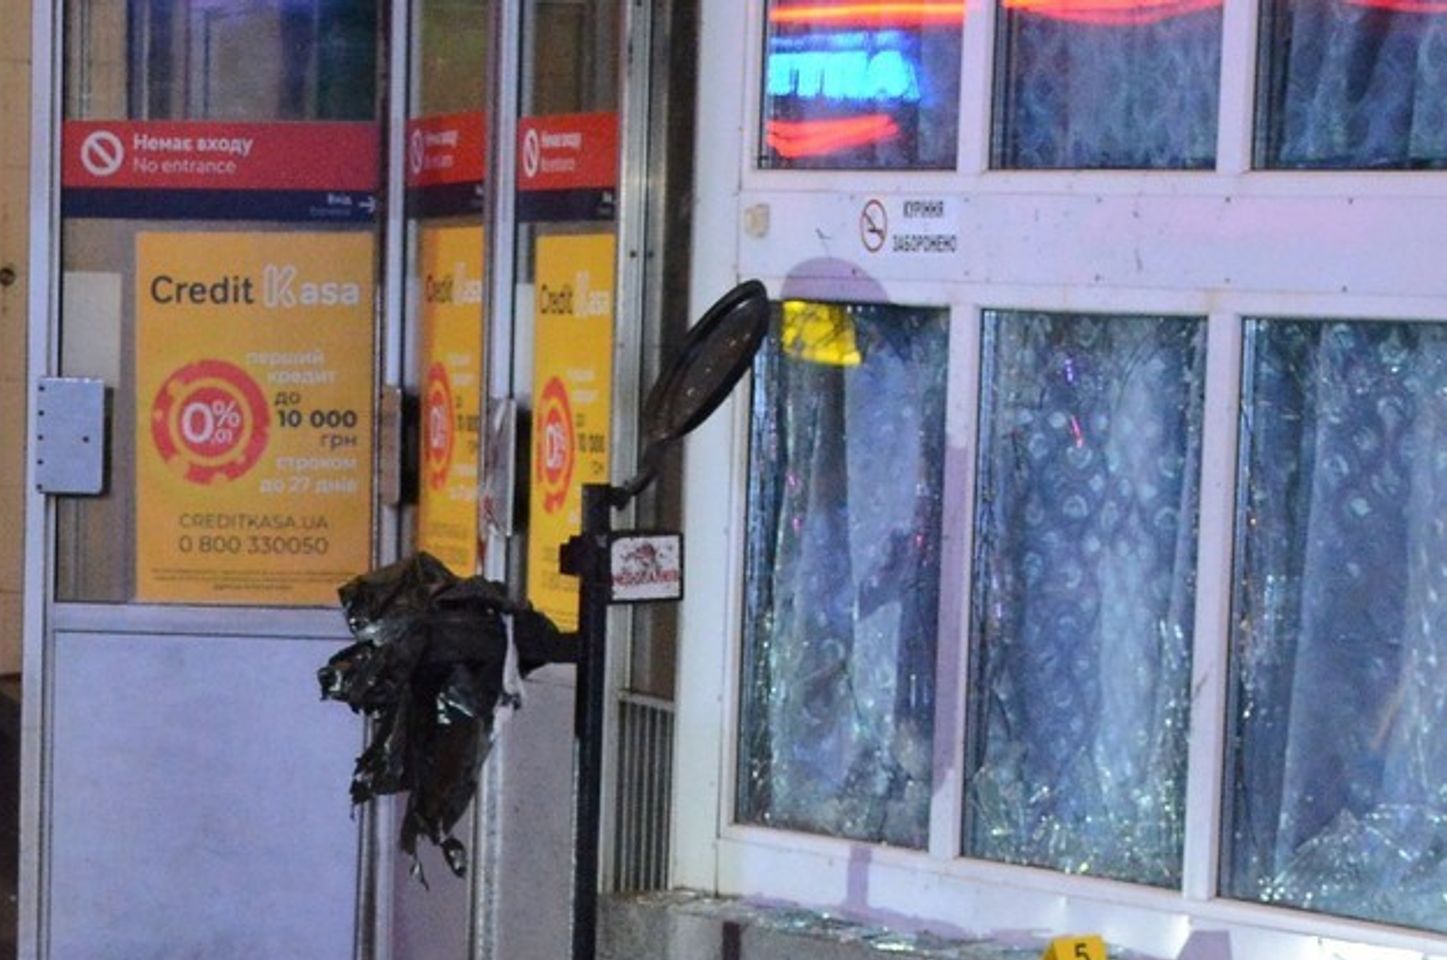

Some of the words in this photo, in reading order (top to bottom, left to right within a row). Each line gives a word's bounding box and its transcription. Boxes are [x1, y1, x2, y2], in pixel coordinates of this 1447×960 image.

[133, 157, 158, 173] No
[162, 159, 237, 174] entrance
[150, 275, 255, 304] Credit
[263, 262, 360, 309] Kasa
[274, 391, 301, 406] до
[278, 410, 302, 428] 10
[309, 410, 358, 428] 000
[321, 434, 358, 450] грн
[179, 512, 329, 531] CREDITKASA.UA
[179, 534, 193, 554] 0
[199, 534, 241, 554] 800
[247, 534, 329, 556] 330050
